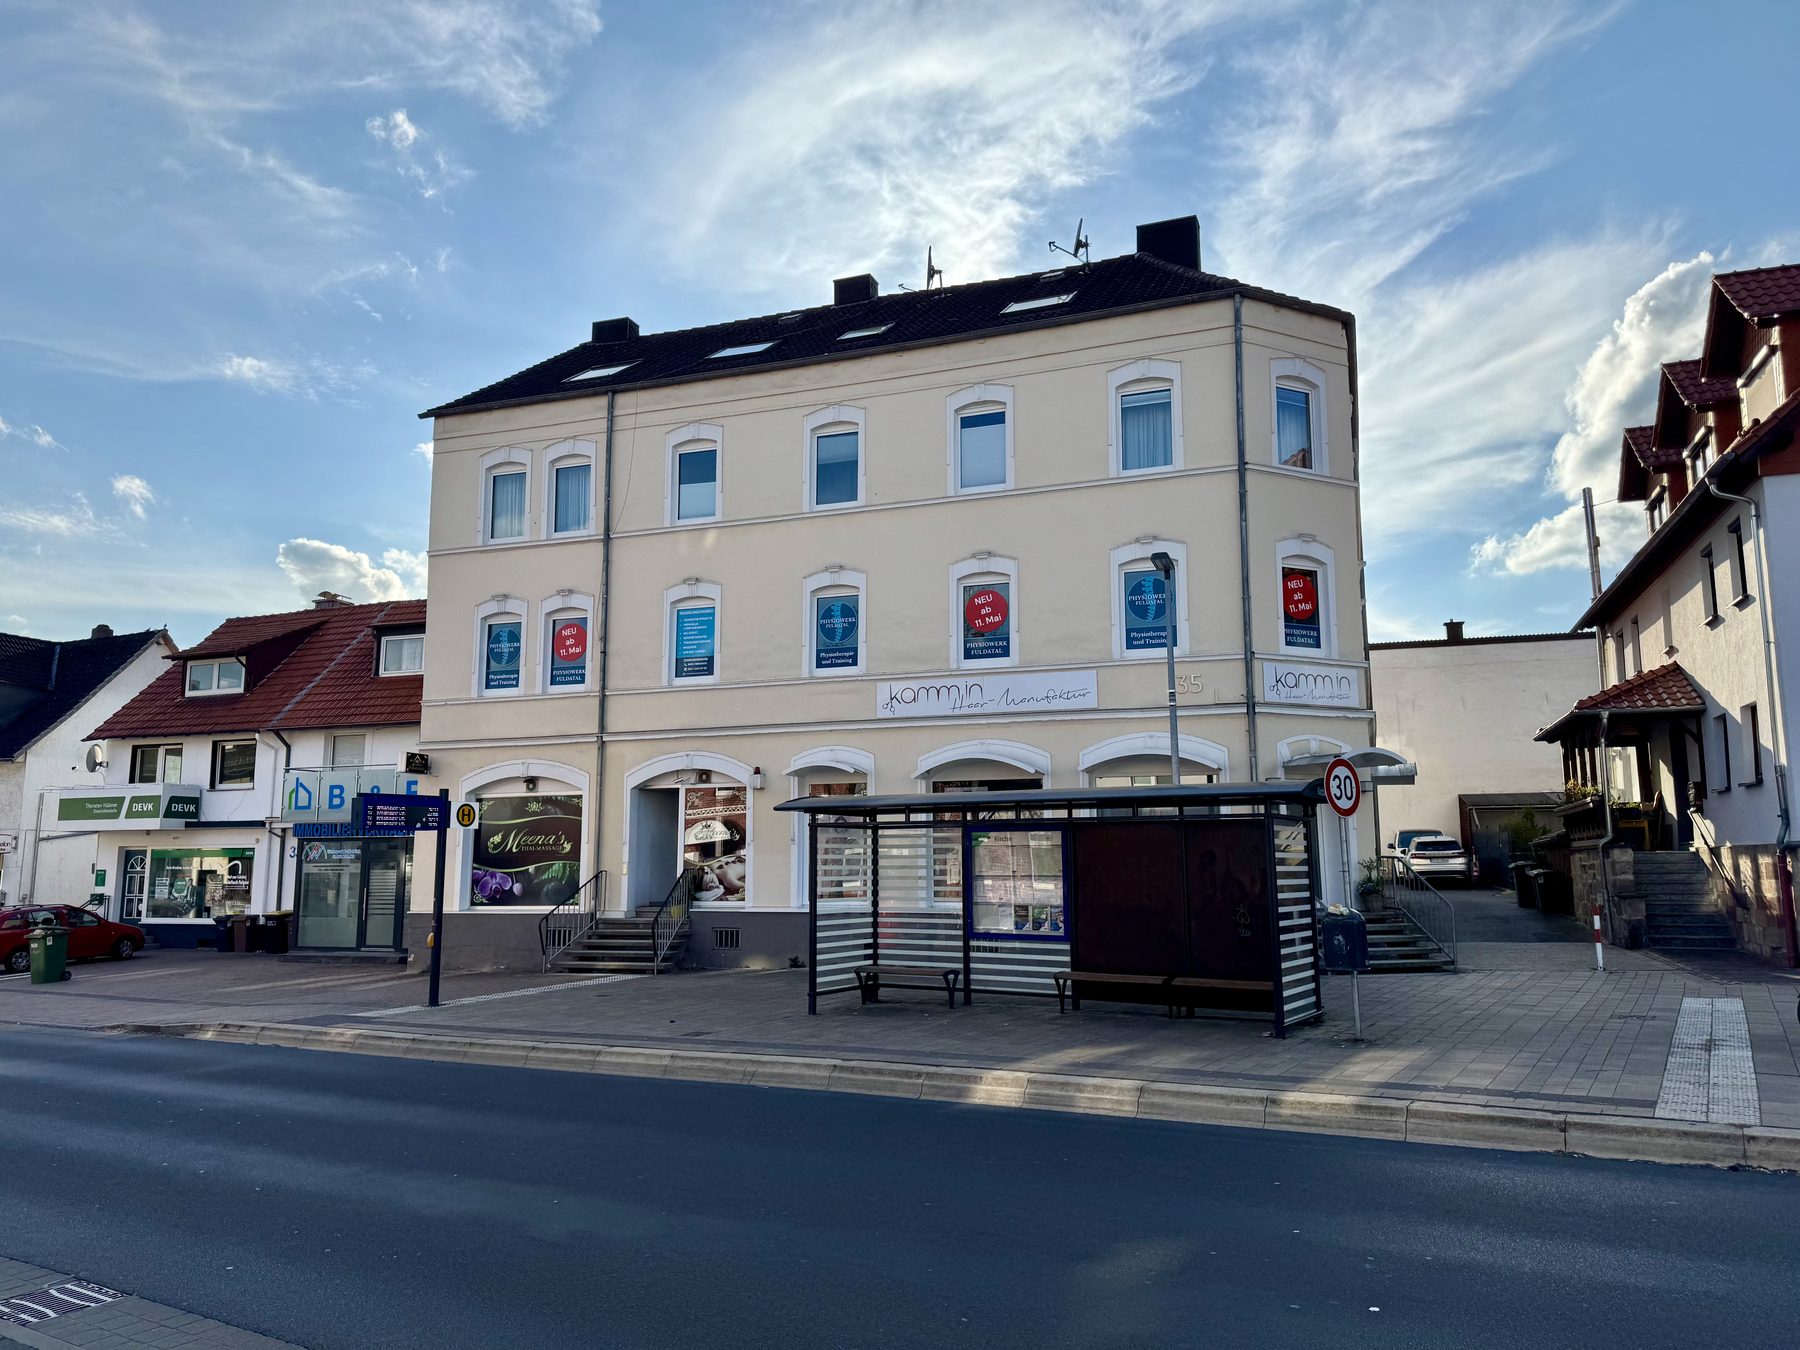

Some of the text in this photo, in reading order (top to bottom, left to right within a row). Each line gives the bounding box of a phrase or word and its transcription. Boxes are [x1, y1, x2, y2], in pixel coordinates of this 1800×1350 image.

[1287, 579, 1304, 590] NEU
[974, 593, 993, 605] NEU
[1293, 591, 1303, 600] ab
[980, 606, 992, 615] ab
[1289, 601, 1313, 613] 11. Mai
[820, 617, 856, 625] PHYSIOWERK
[974, 613, 1002, 628] 11. Mai
[561, 627, 577, 637] NEU
[1130, 630, 1168, 639] Physiotherap
[565, 637, 575, 646] ab
[967, 640, 1008, 649] PHYSIOWERK
[1145, 637, 1168, 645] Trainin
[559, 645, 582, 657] 11. Mai
[820, 650, 855, 659] Physiotherapie
[971, 648, 1004, 656] FULDATAL
[831, 657, 853, 665] Training
[552, 668, 587, 676] PHYSIOWERK
[1176, 673, 1204, 694] 35
[1332, 774, 1354, 801] 30
[327, 784, 346, 810] B
[132, 802, 154, 812] DEVK
[171, 803, 196, 813] DEVK
[461, 806, 471, 823] H
[496, 827, 565, 853] Meena's
